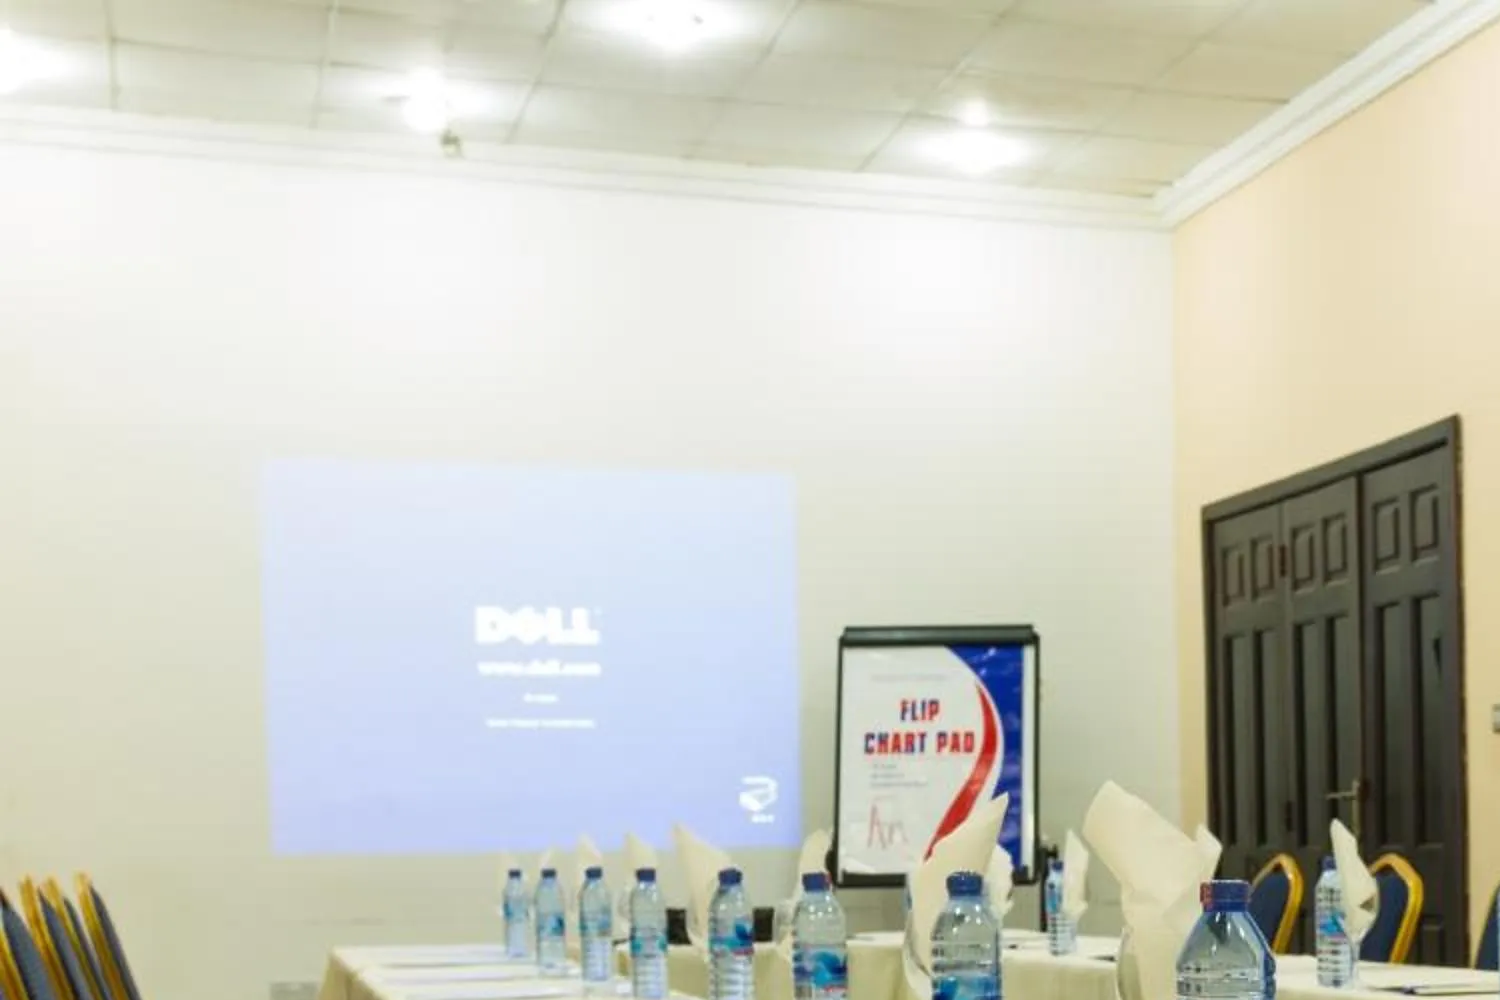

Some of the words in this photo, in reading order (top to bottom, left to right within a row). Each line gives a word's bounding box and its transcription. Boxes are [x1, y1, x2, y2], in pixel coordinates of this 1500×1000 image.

[899, 699, 940, 721] FLIP
[864, 731, 927, 754] CHART
[936, 731, 975, 753] PAD
